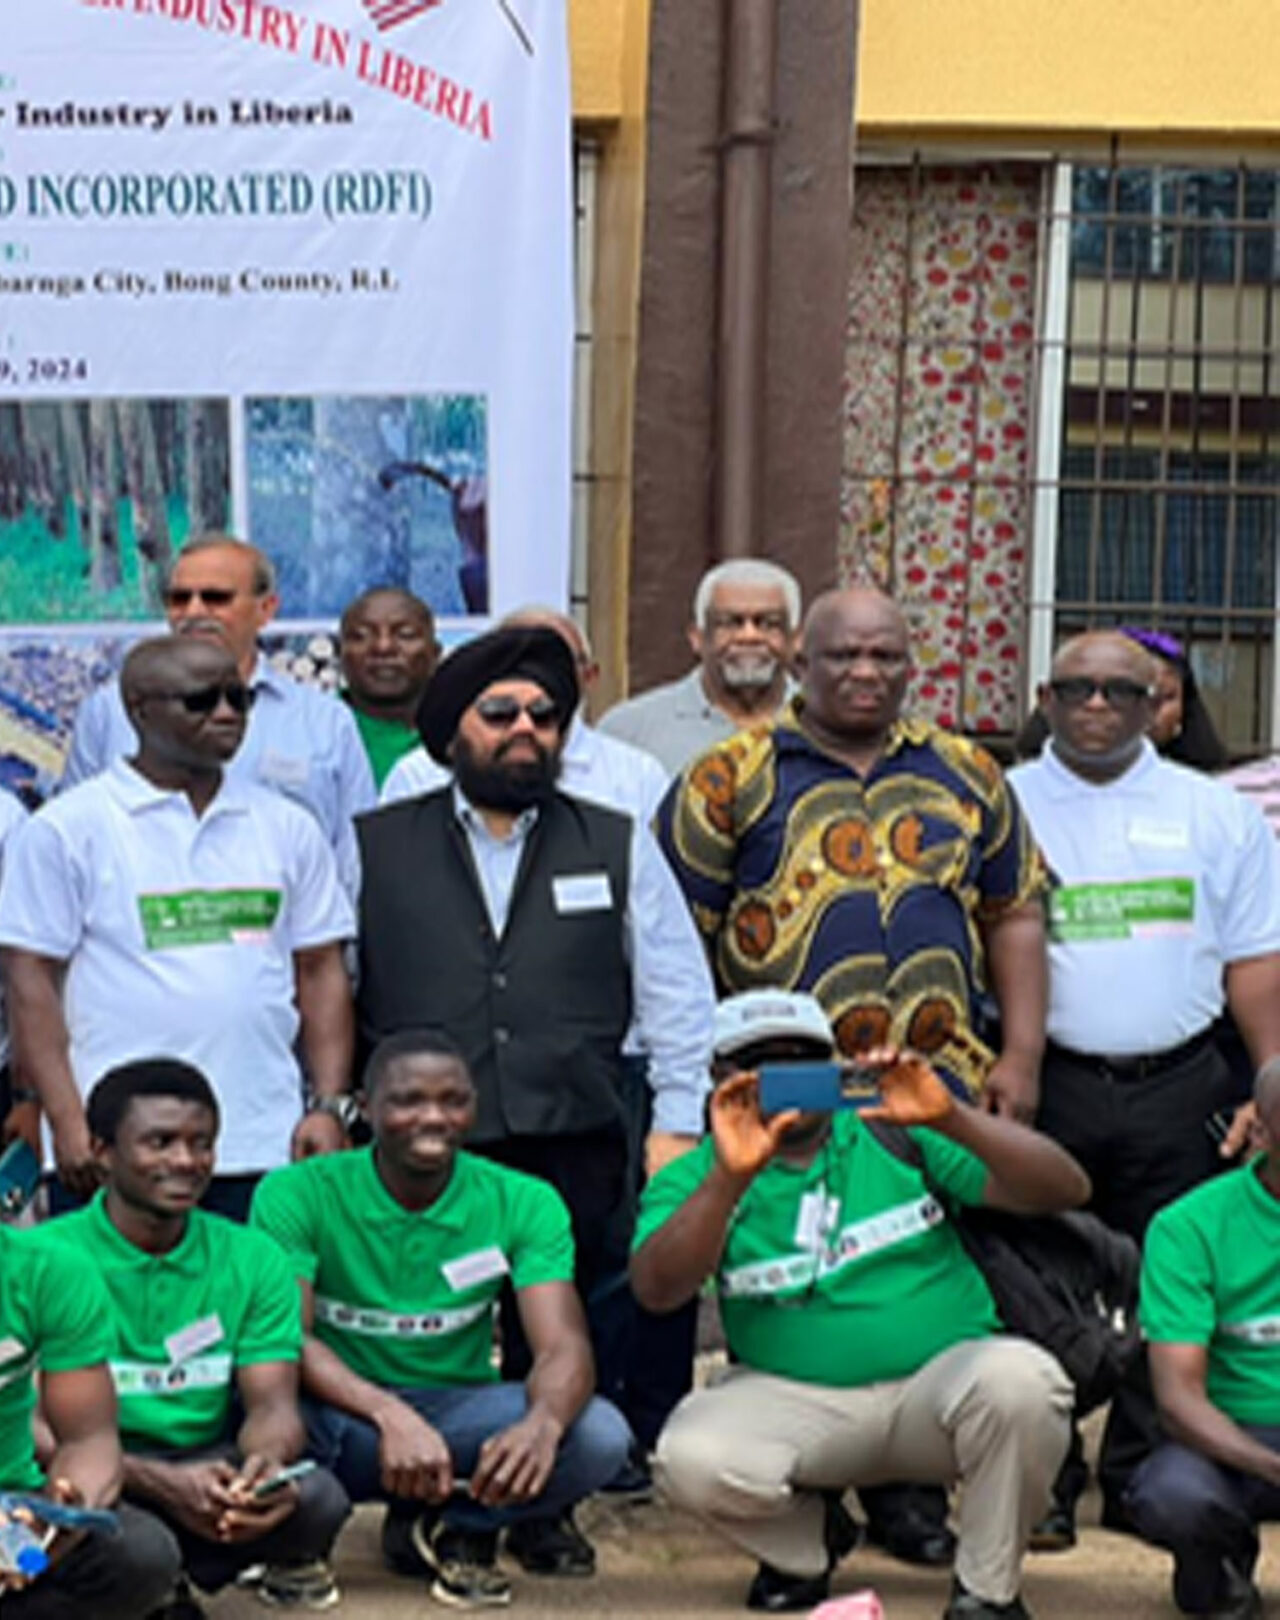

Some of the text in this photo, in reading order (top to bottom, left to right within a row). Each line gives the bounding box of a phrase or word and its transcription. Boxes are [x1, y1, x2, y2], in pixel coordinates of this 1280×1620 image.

[312, 21, 349, 69] IN
[356, 40, 492, 141] LIBERIA
[16, 101, 172, 131] Industry
[183, 100, 218, 126] in
[229, 98, 353, 126] Liberia
[26, 171, 315, 218] INCORPORATED
[323, 169, 433, 222] (RDFI)
[93, 271, 157, 297] City,
[164, 270, 232, 297] Bong
[239, 269, 343, 294] County,
[27, 358, 88, 382] 2024
